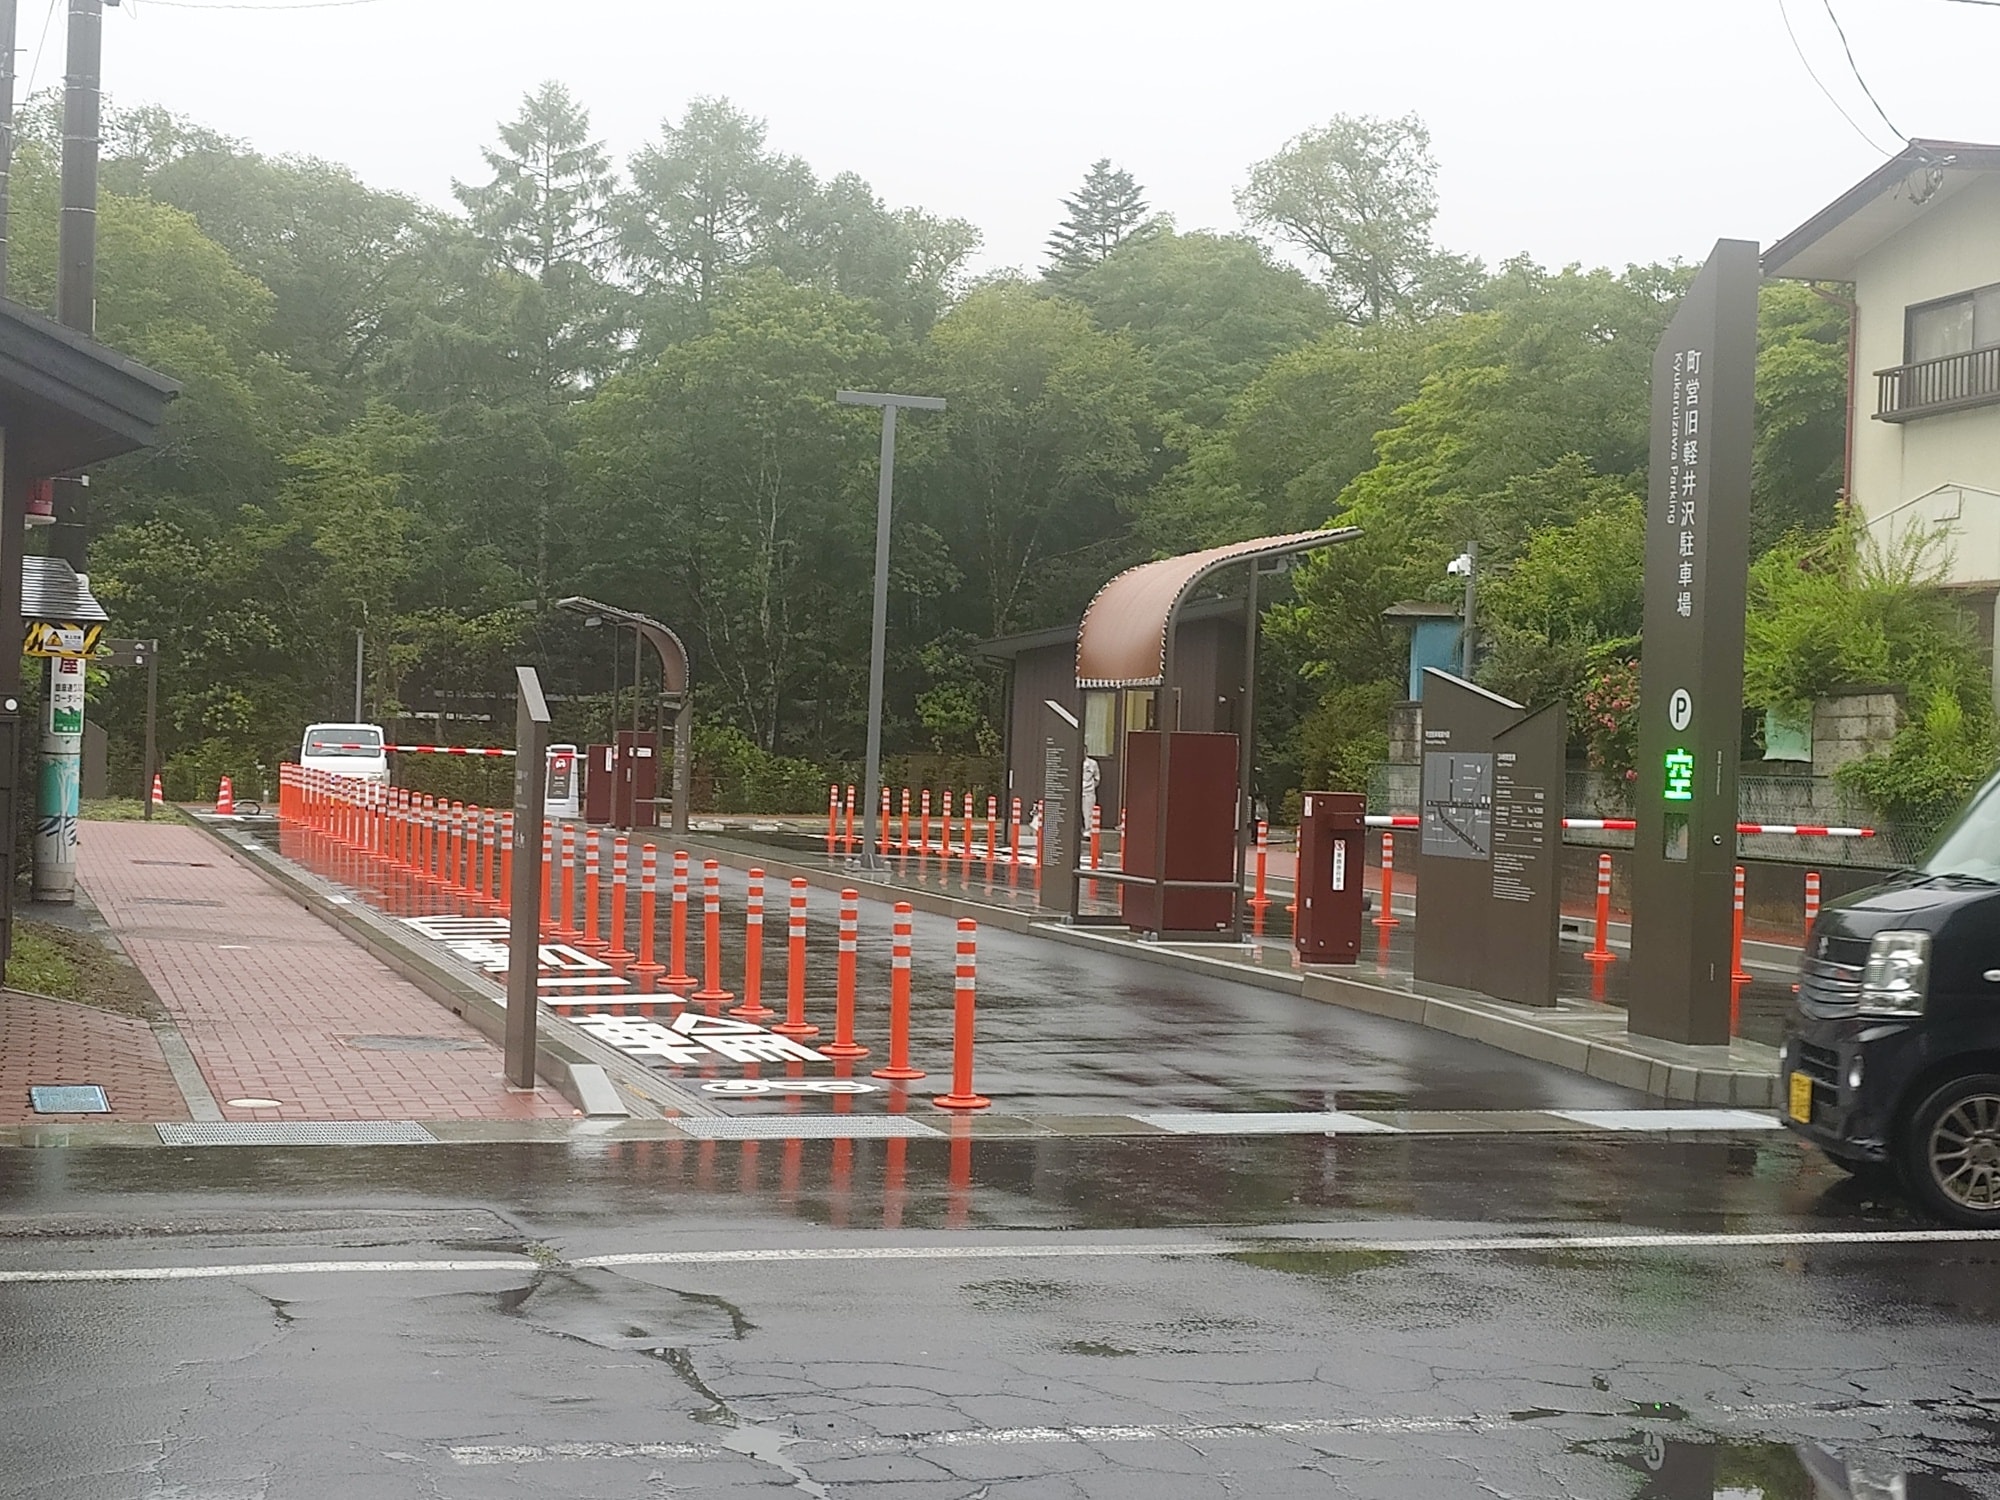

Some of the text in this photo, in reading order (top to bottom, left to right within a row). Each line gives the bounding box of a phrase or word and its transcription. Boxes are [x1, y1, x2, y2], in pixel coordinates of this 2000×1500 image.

[1667, 352, 1683, 524] Kyukaruizawa Parking
[1677, 350, 1701, 617] 町営旧軽井沢駐車場
[1676, 697, 1687, 723] P
[1664, 748, 1693, 800] 空
